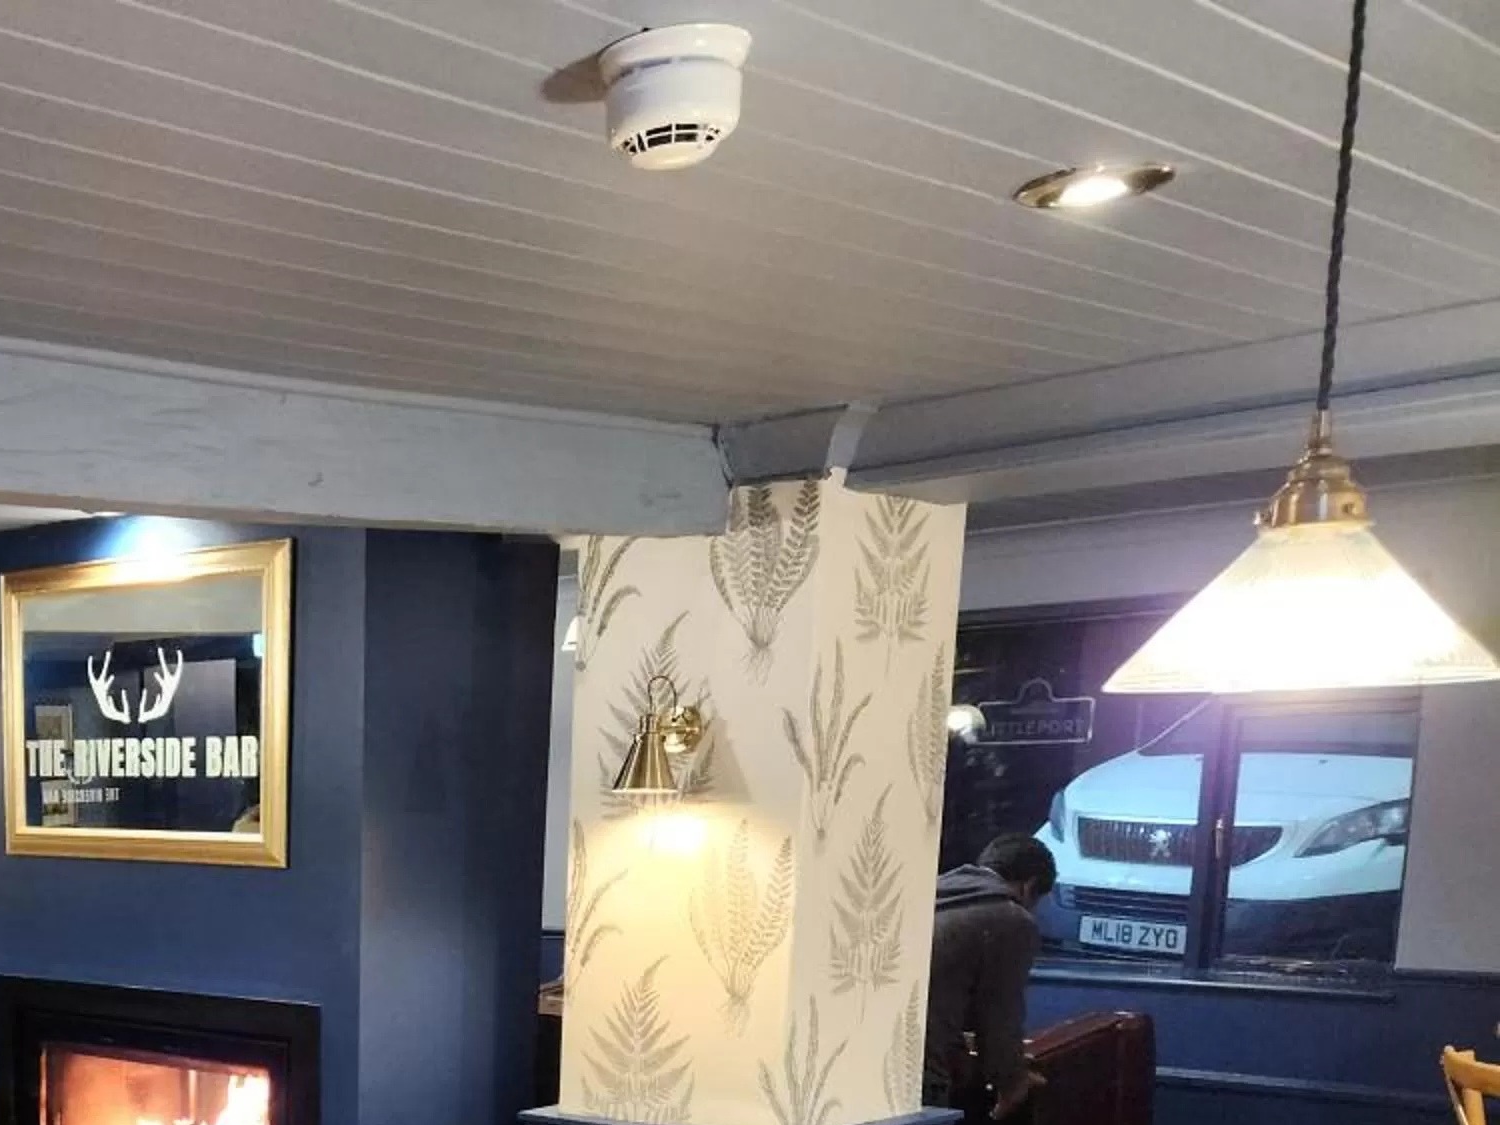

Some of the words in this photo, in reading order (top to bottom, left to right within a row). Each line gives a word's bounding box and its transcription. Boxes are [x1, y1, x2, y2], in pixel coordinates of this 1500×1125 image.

[25, 738, 66, 778] THE
[74, 736, 197, 778] RIVERSIDE
[206, 735, 260, 778] BAR
[1092, 918, 1133, 944] ML18
[1138, 925, 1178, 949] ZYO
